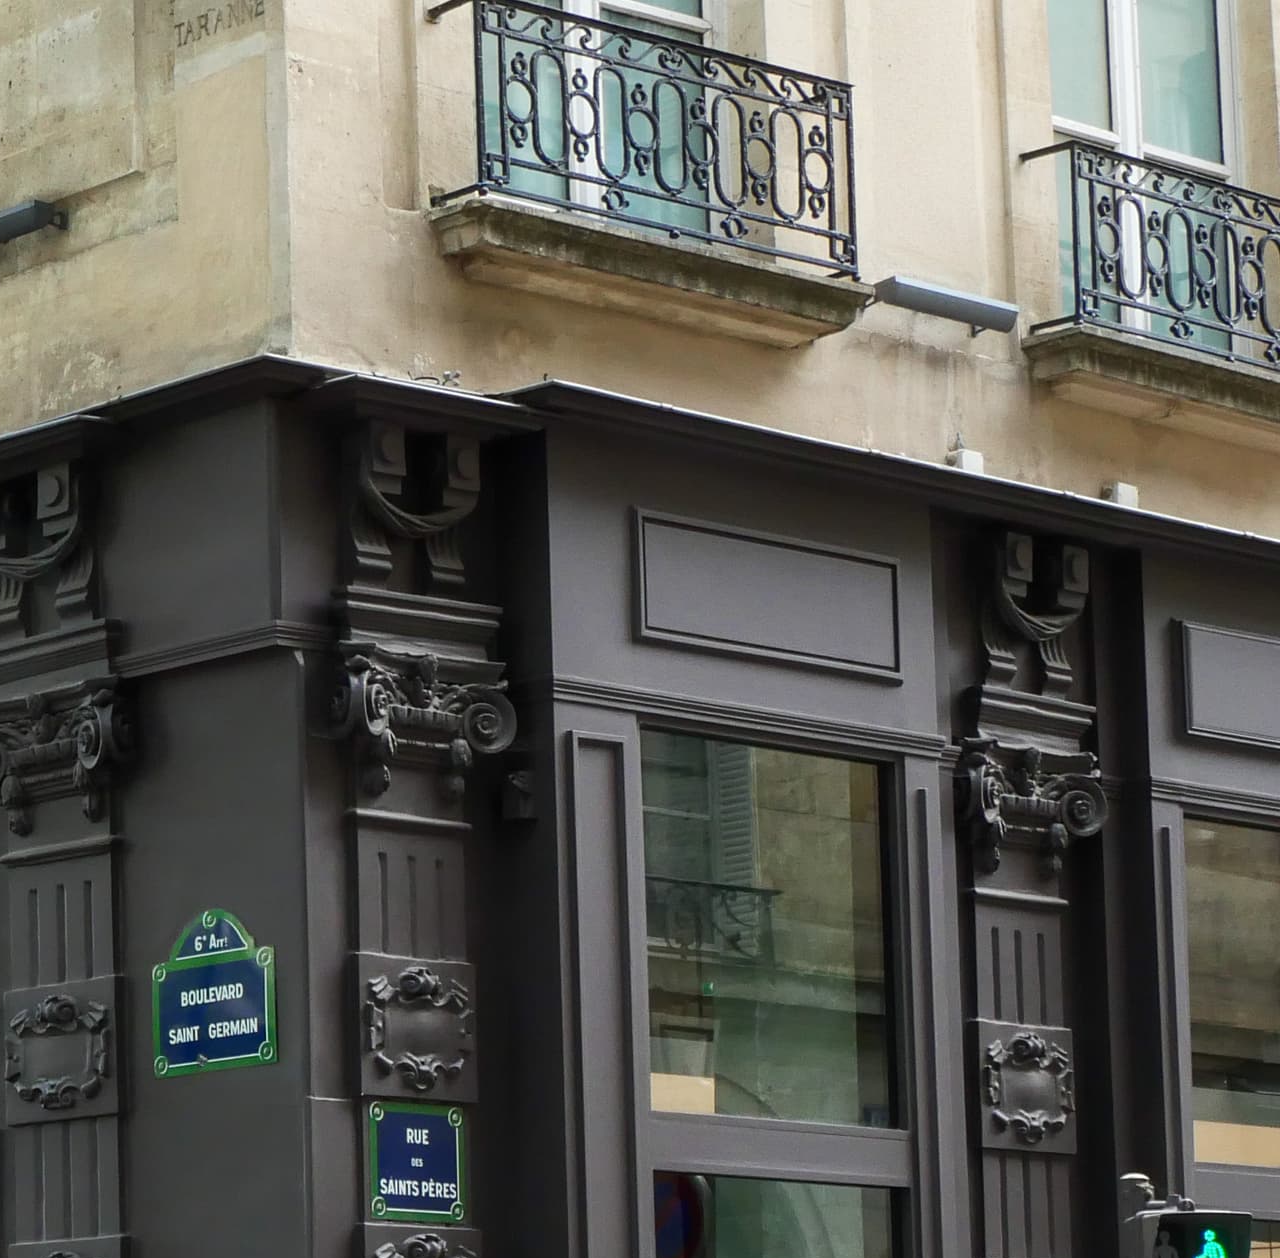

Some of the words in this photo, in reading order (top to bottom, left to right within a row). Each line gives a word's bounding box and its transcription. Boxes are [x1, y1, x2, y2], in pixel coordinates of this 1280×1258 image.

[181, 983, 244, 1008] BOULEVARD
[168, 1026, 200, 1045] SAINT
[208, 1017, 258, 1039] GERMAIN
[406, 1128, 430, 1145] RUE
[411, 1157, 424, 1168] DES
[380, 1178, 420, 1197] SAINTS
